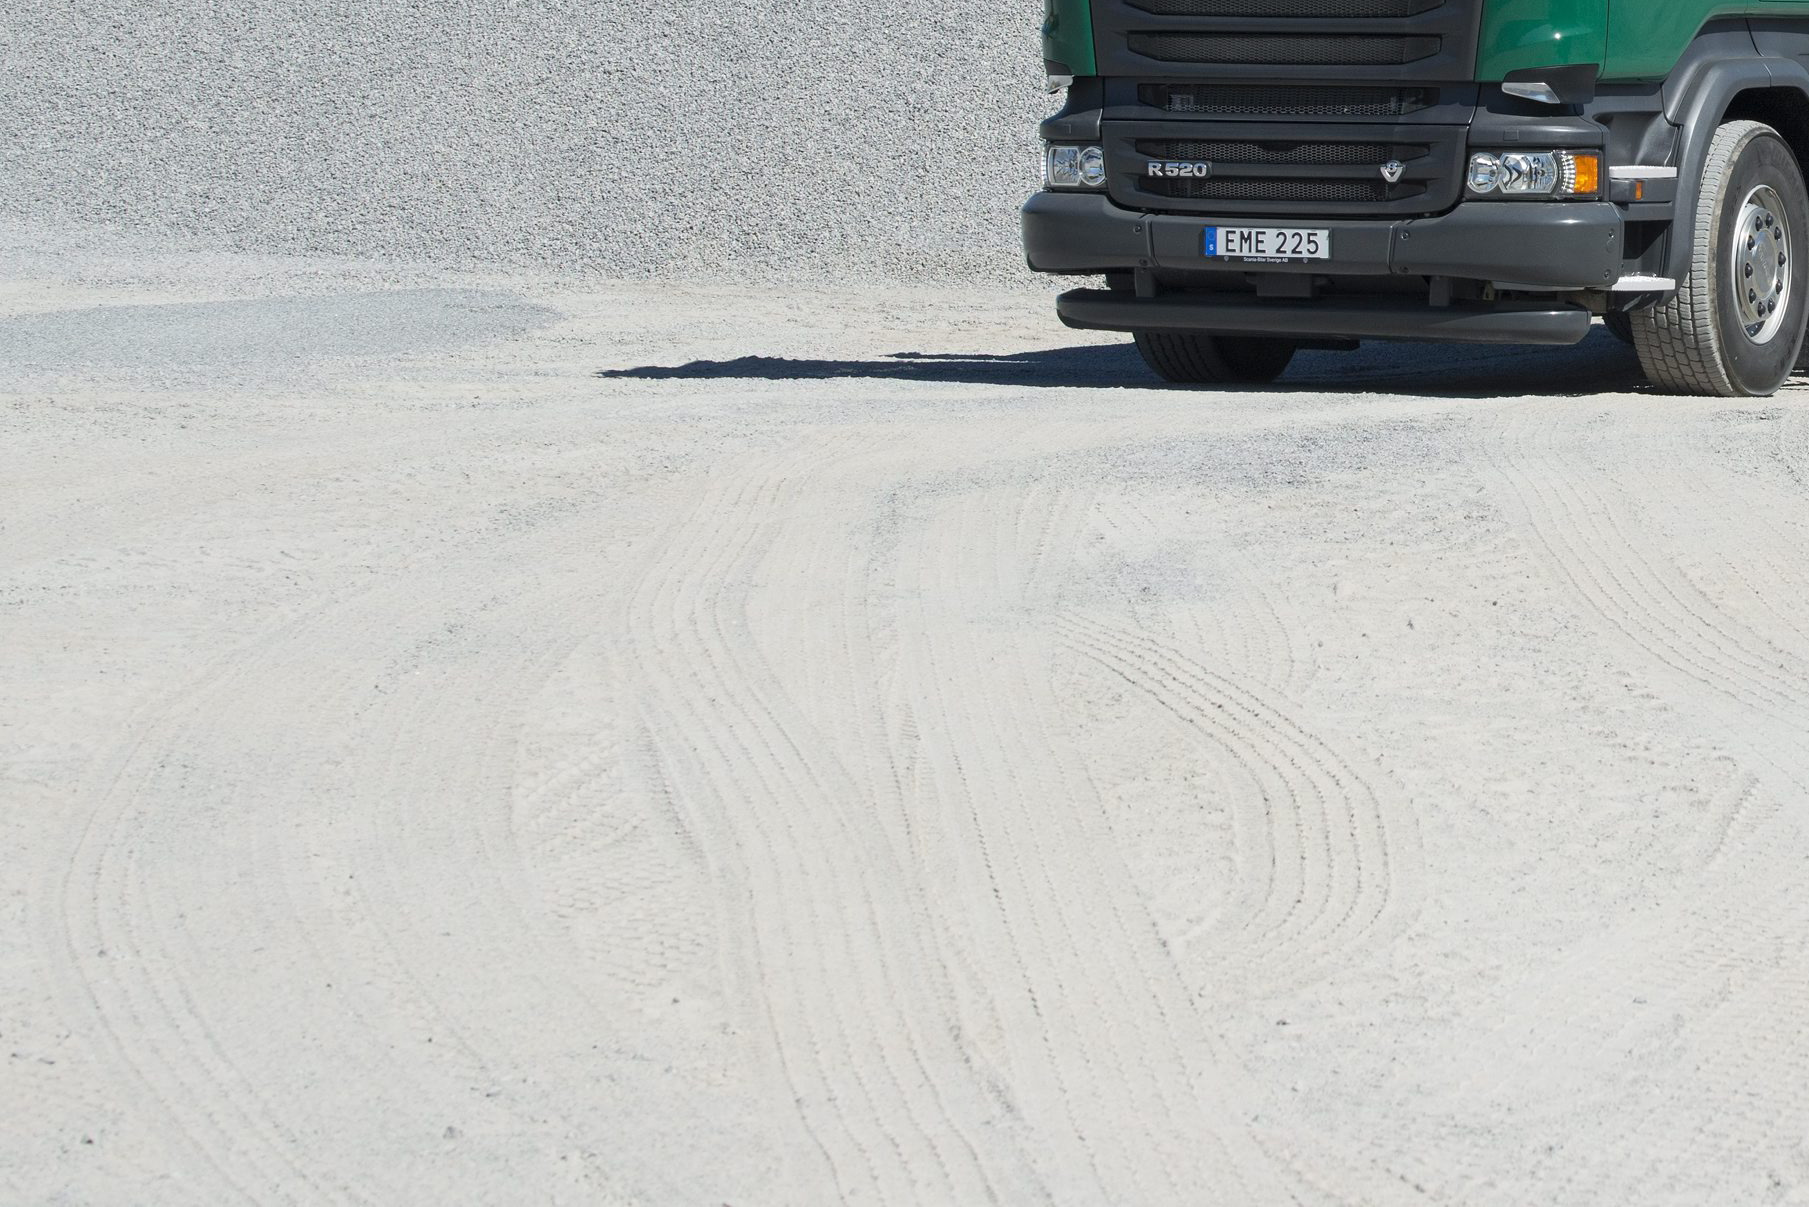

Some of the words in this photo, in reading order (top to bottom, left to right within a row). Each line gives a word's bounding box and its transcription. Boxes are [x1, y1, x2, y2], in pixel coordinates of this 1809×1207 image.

[1148, 162, 1163, 176] R
[1165, 162, 1207, 177] 520
[1225, 230, 1266, 253] EME
[1275, 231, 1319, 255] 225
